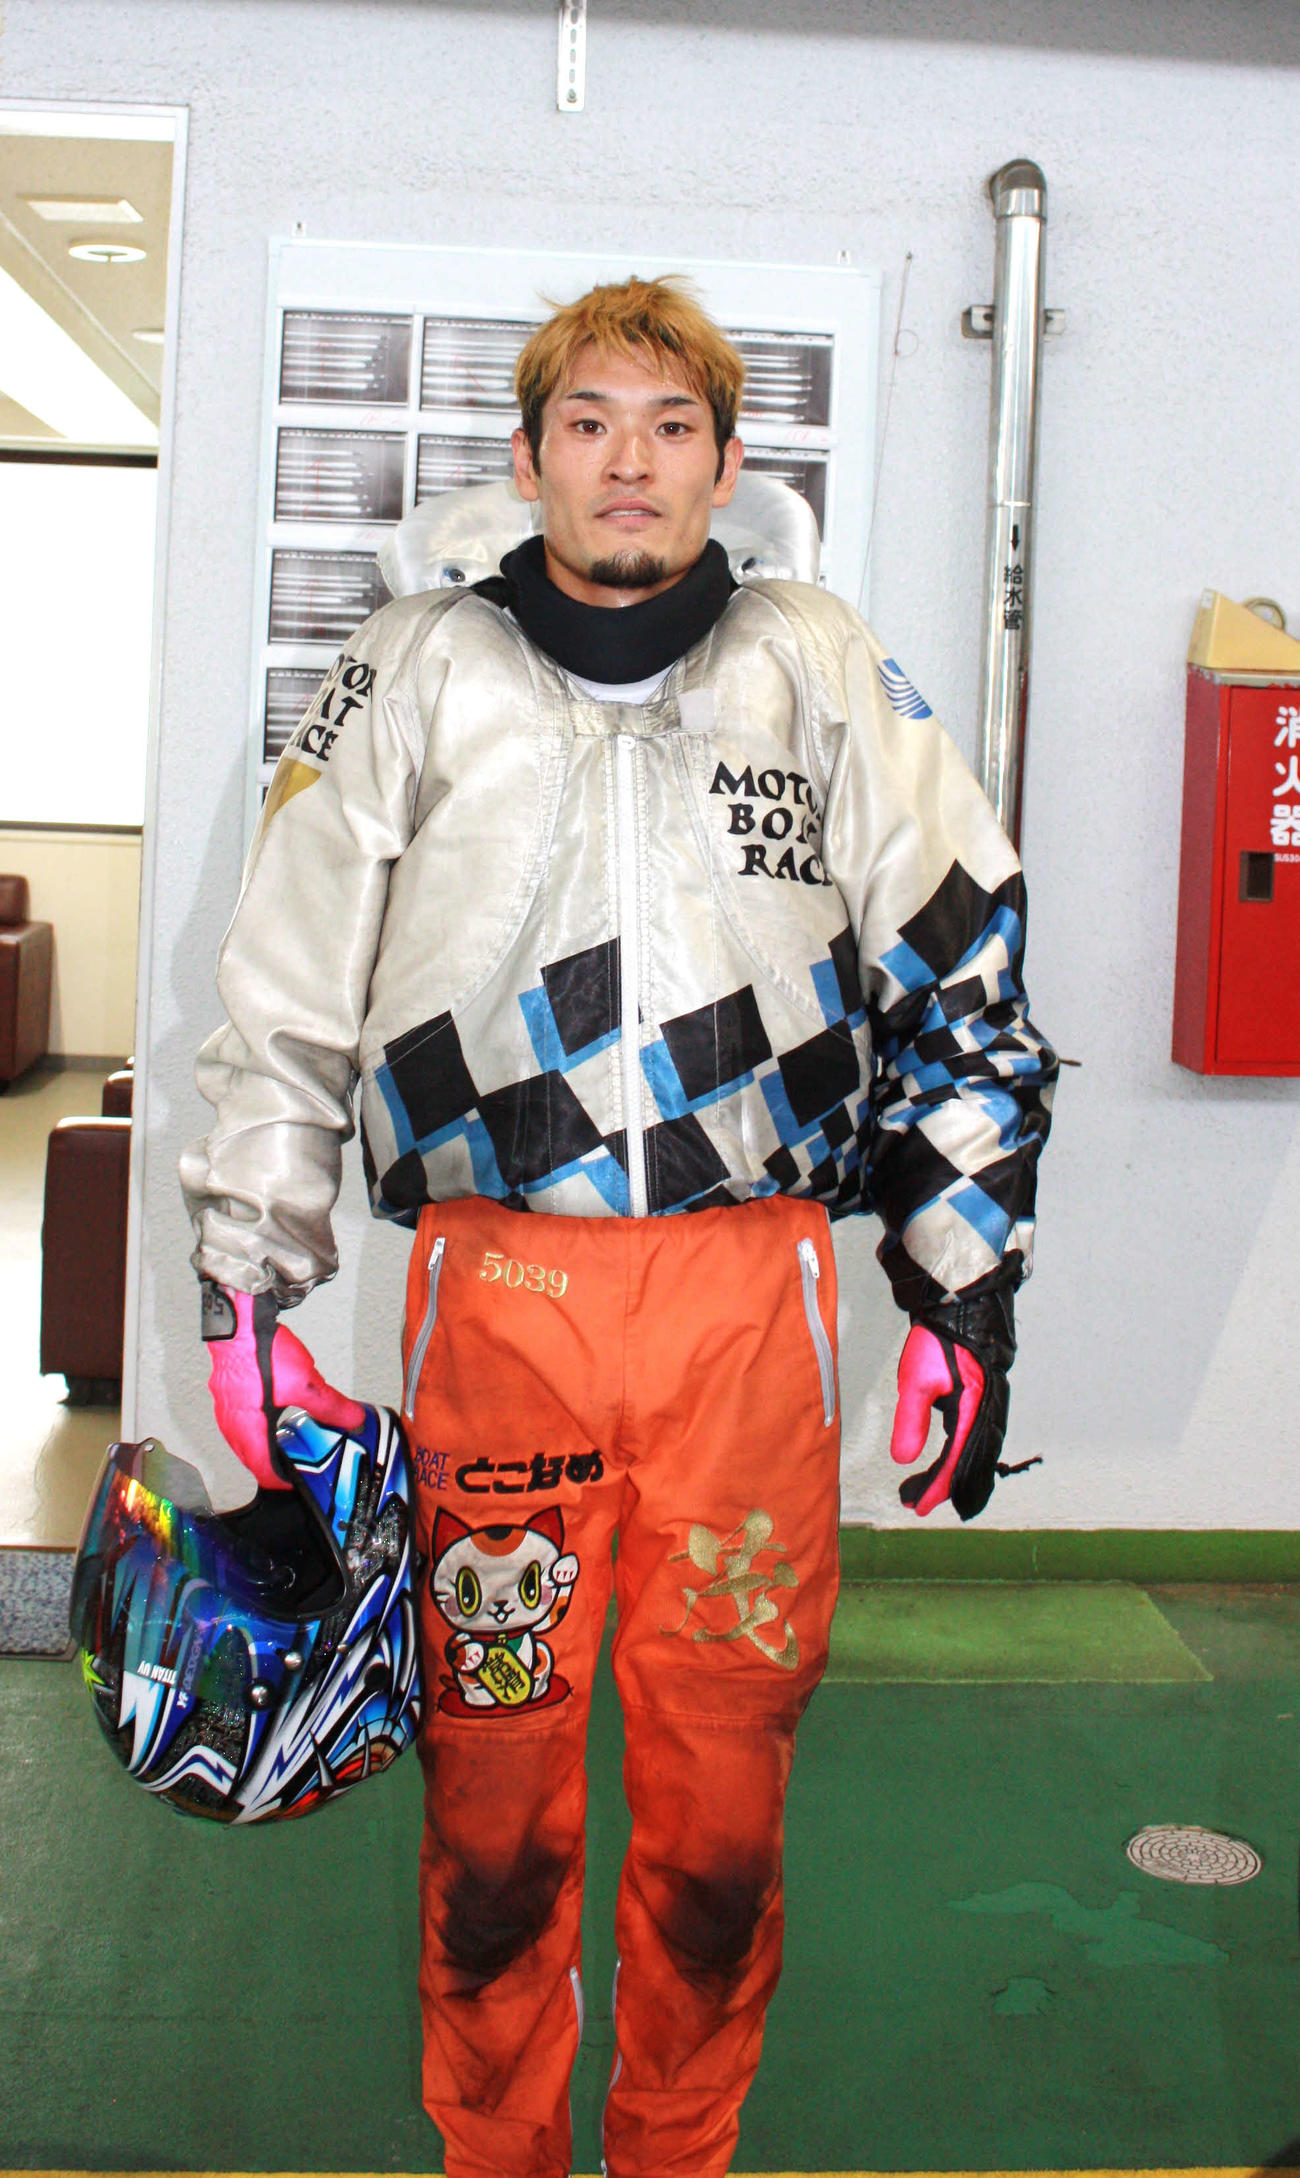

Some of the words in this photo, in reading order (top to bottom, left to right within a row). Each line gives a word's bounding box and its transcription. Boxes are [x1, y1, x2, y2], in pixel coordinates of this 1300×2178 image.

[1270, 705, 1300, 847] 消火器
[479, 1251, 568, 1299] 5039
[455, 1450, 604, 1494] とこなめ
[136, 1660, 152, 1677] UV
[150, 1663, 178, 1686] TITAN
